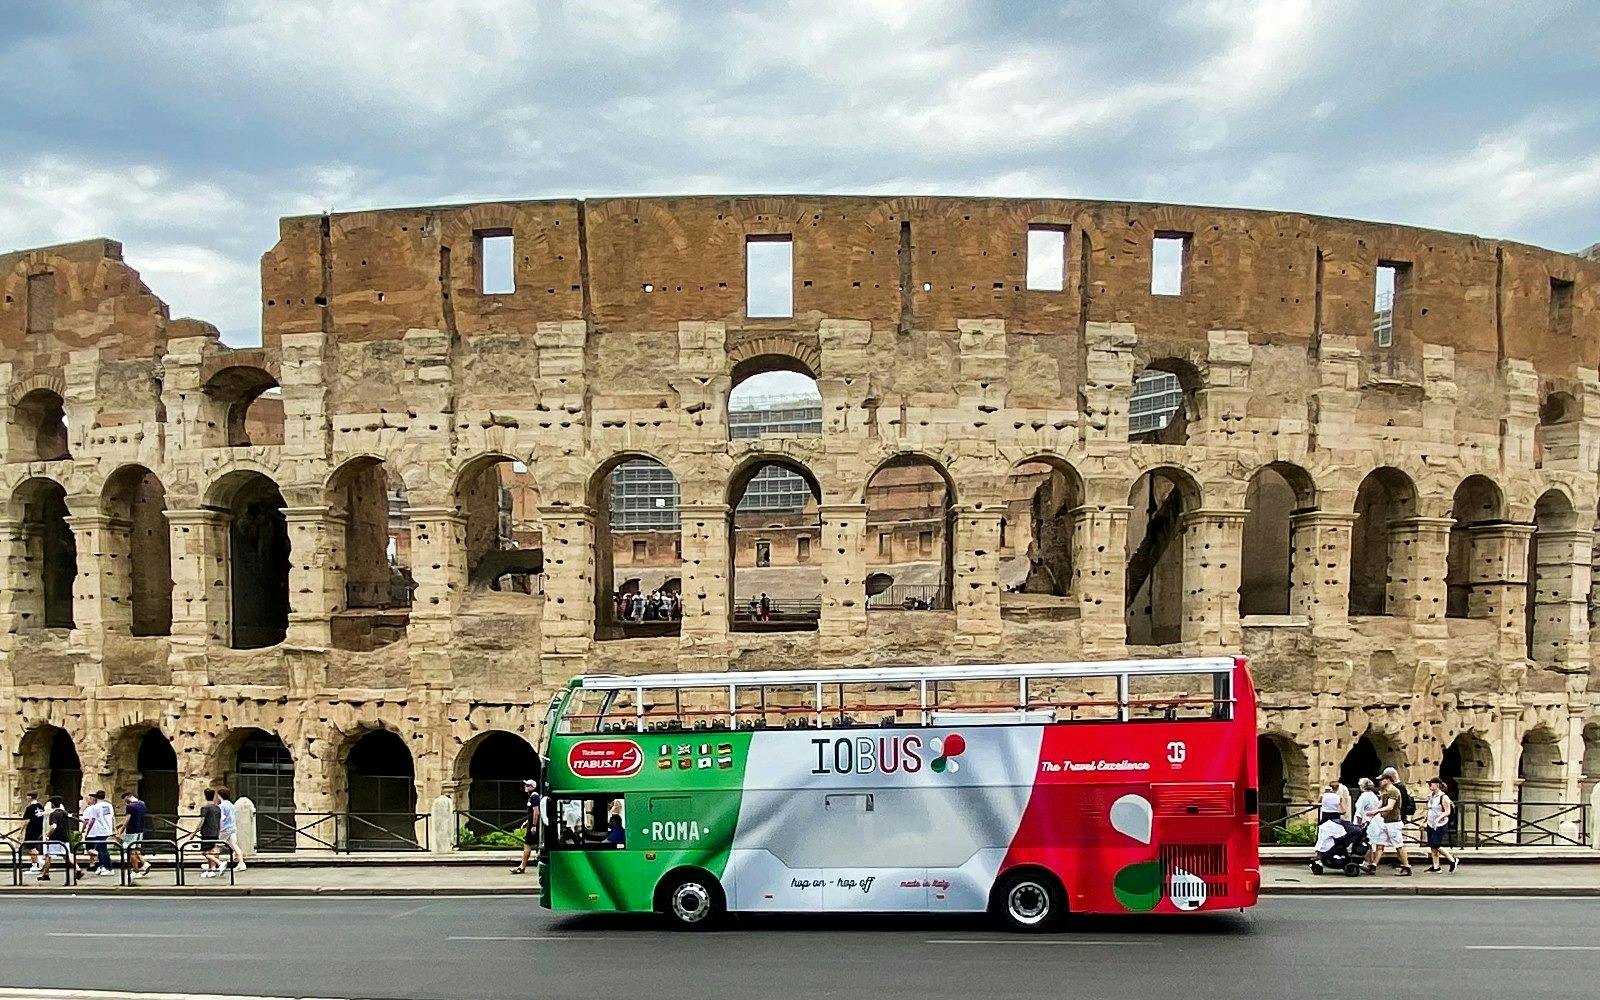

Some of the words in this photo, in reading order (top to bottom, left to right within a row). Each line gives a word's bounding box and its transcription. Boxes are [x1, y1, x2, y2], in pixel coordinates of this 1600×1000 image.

[811, 736, 923, 775] IOBUS
[573, 760, 624, 769] ITABUS.IT
[1041, 761, 1061, 772] The
[1063, 760, 1096, 771] Travel
[1097, 759, 1151, 771] Excellence
[652, 821, 700, 841] ROMA
[790, 877, 811, 890] hop
[812, 879, 826, 888] on
[836, 877, 857, 890] hop
[859, 876, 876, 893] off
[899, 880, 921, 888] made
[931, 879, 951, 891] Italy
